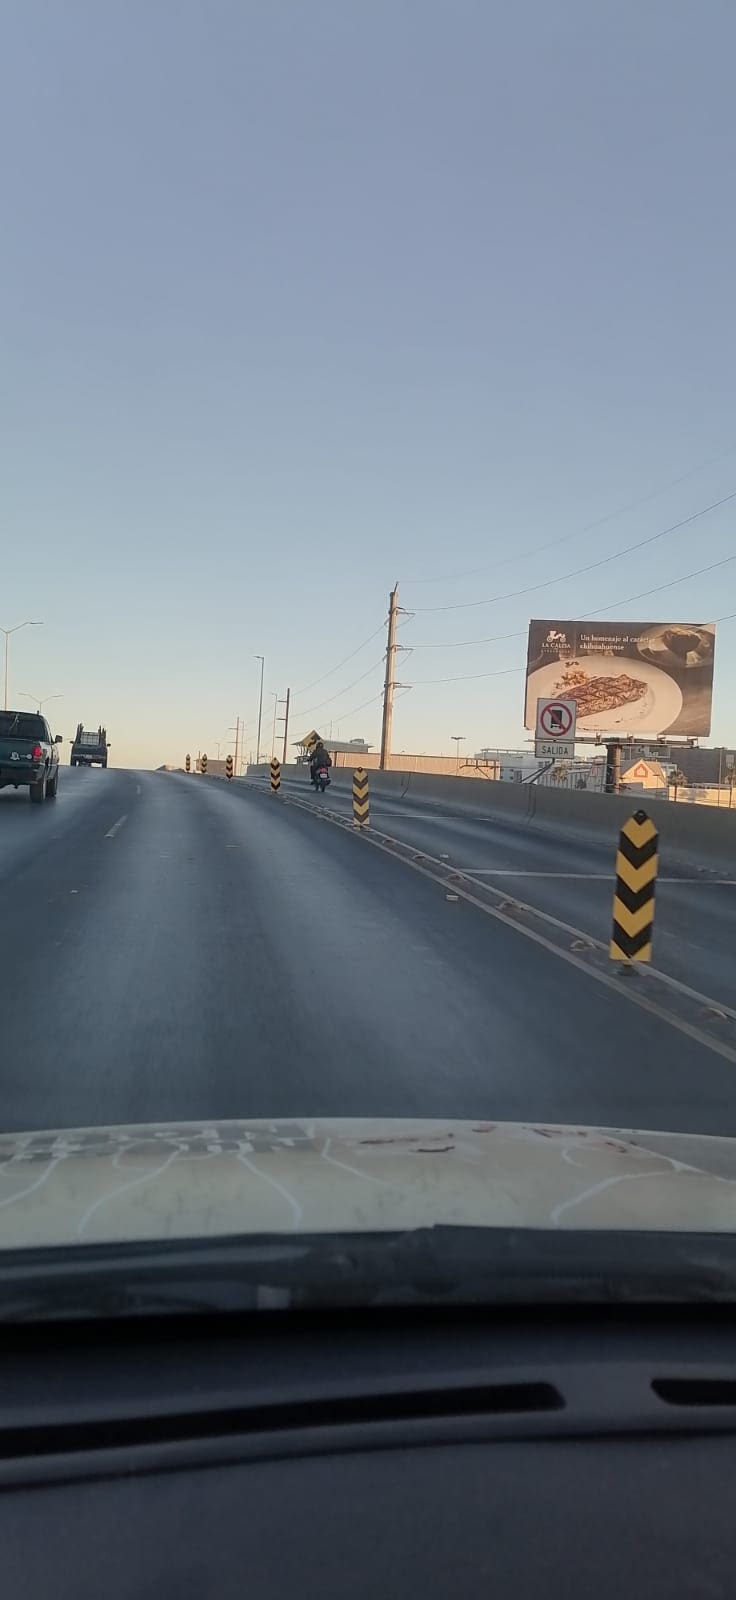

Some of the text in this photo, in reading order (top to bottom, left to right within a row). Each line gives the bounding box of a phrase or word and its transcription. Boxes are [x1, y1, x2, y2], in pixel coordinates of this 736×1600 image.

[591, 634, 622, 643] homenaje
[622, 635, 629, 643] al
[579, 643, 625, 651] chihuahuense
[541, 745, 569, 755] SALIDA
